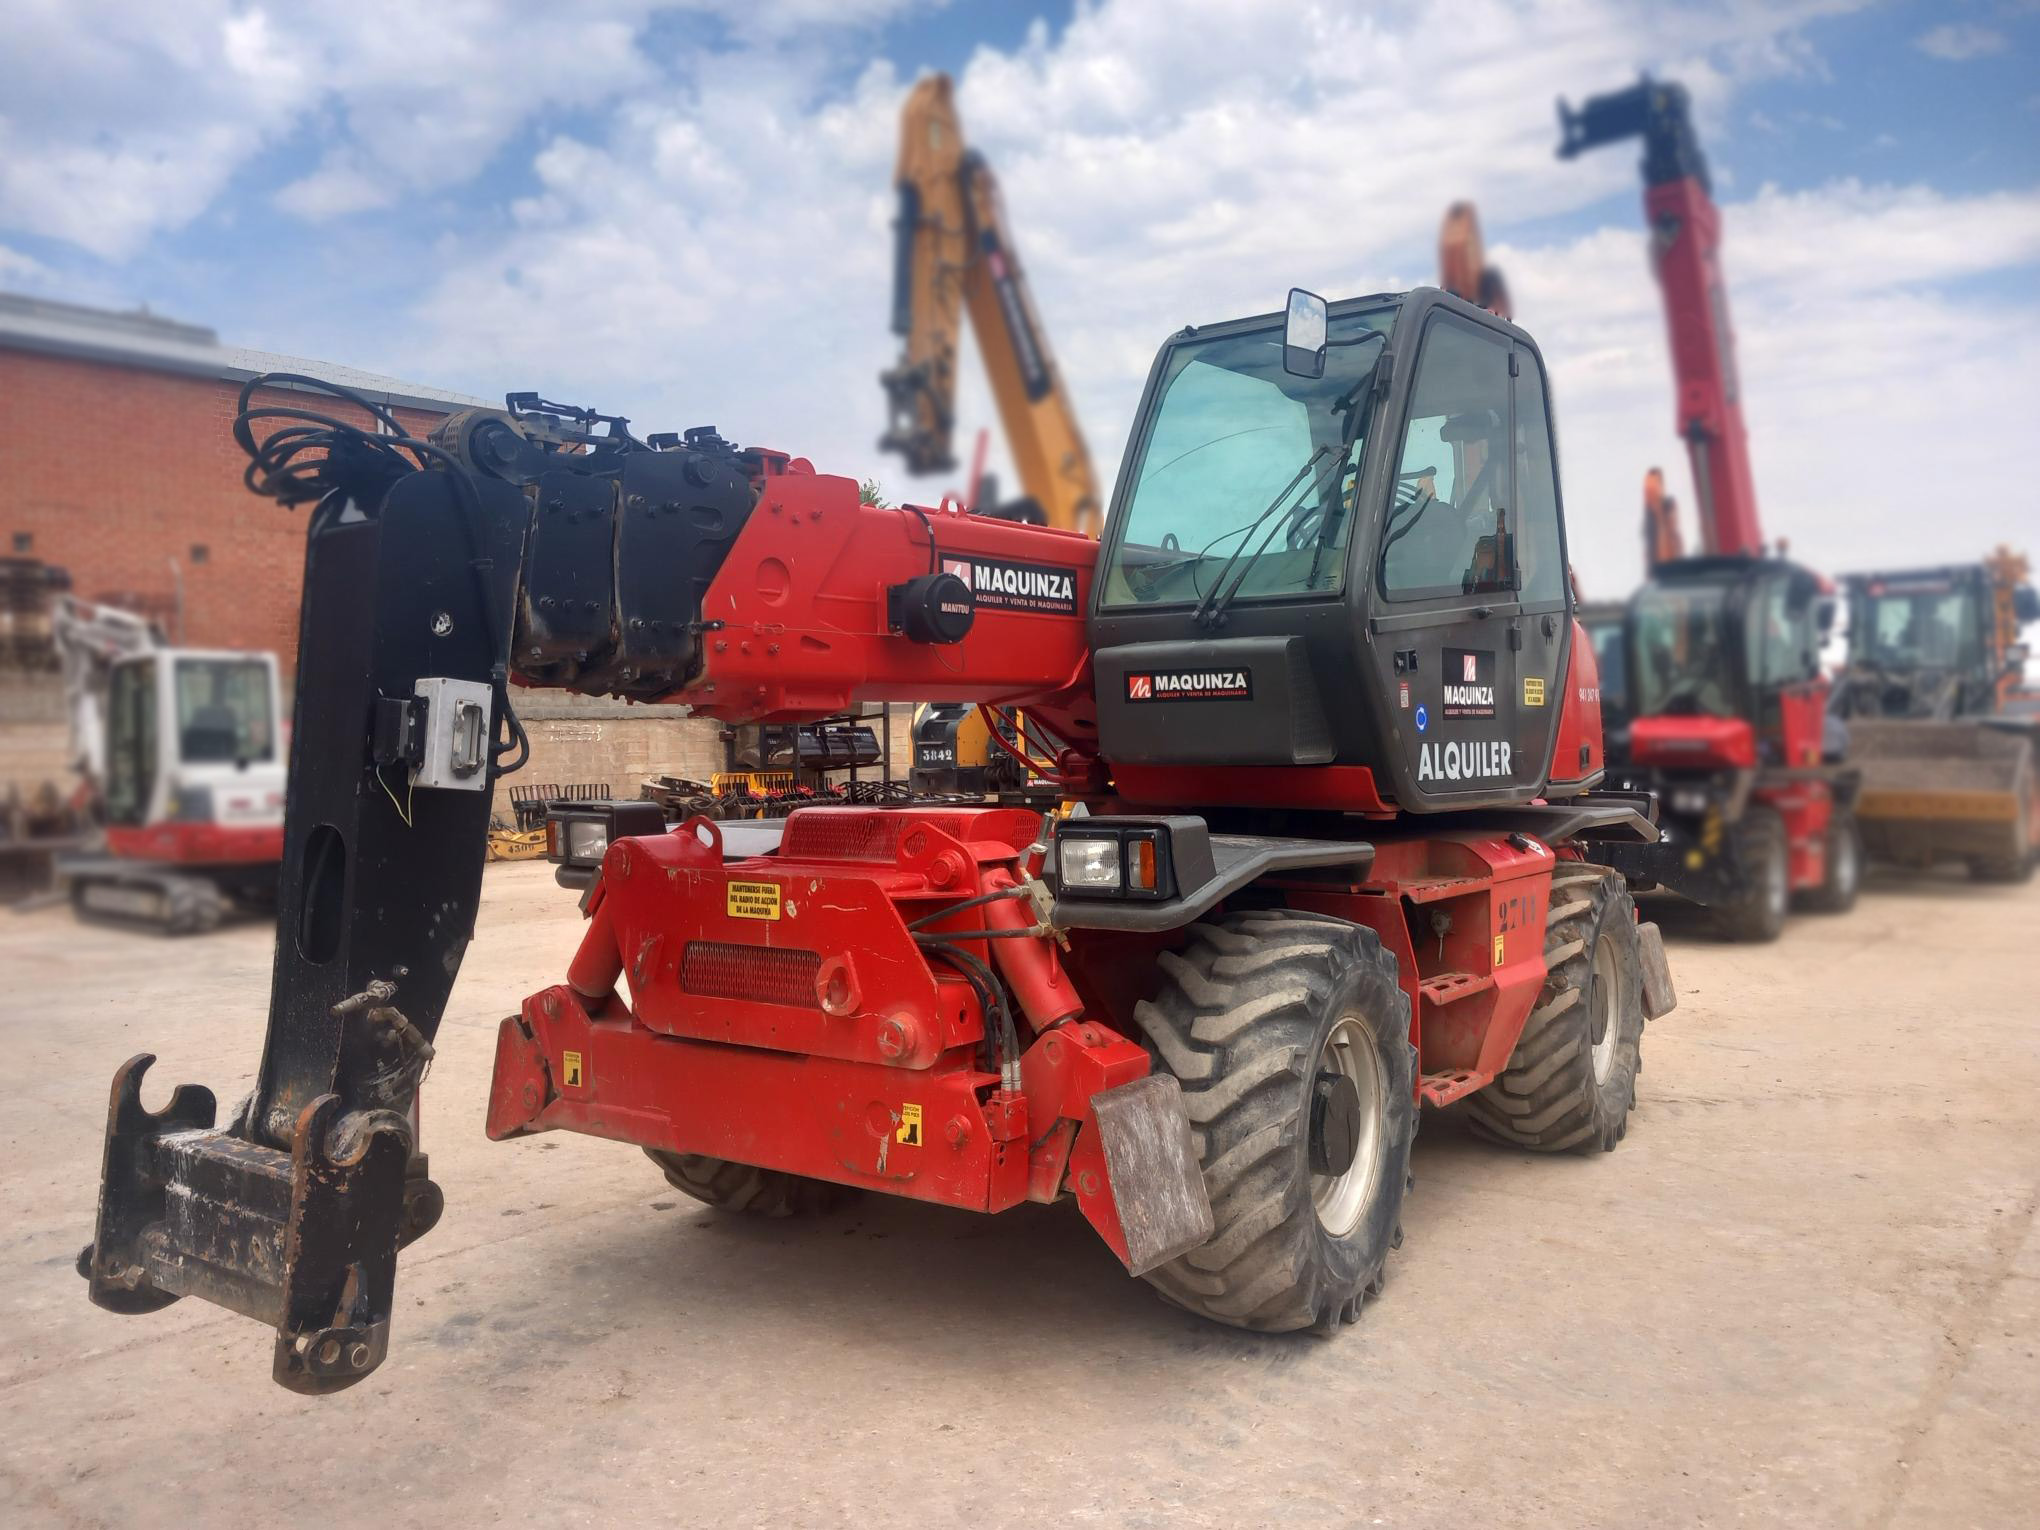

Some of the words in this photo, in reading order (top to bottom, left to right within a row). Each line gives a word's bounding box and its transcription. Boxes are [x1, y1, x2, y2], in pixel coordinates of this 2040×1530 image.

[975, 565, 1073, 599] MAQUINZA
[941, 602, 969, 614] MANITOU
[976, 593, 1002, 604] ALQUILER
[1009, 597, 1027, 606] VENTA
[1038, 601, 1072, 610] MAQUINARIA
[1155, 672, 1247, 690] MAQUINZA
[1444, 686, 1494, 705] MAQUINZA
[923, 749, 952, 761] 3842
[1418, 741, 1512, 781] ALQUILER
